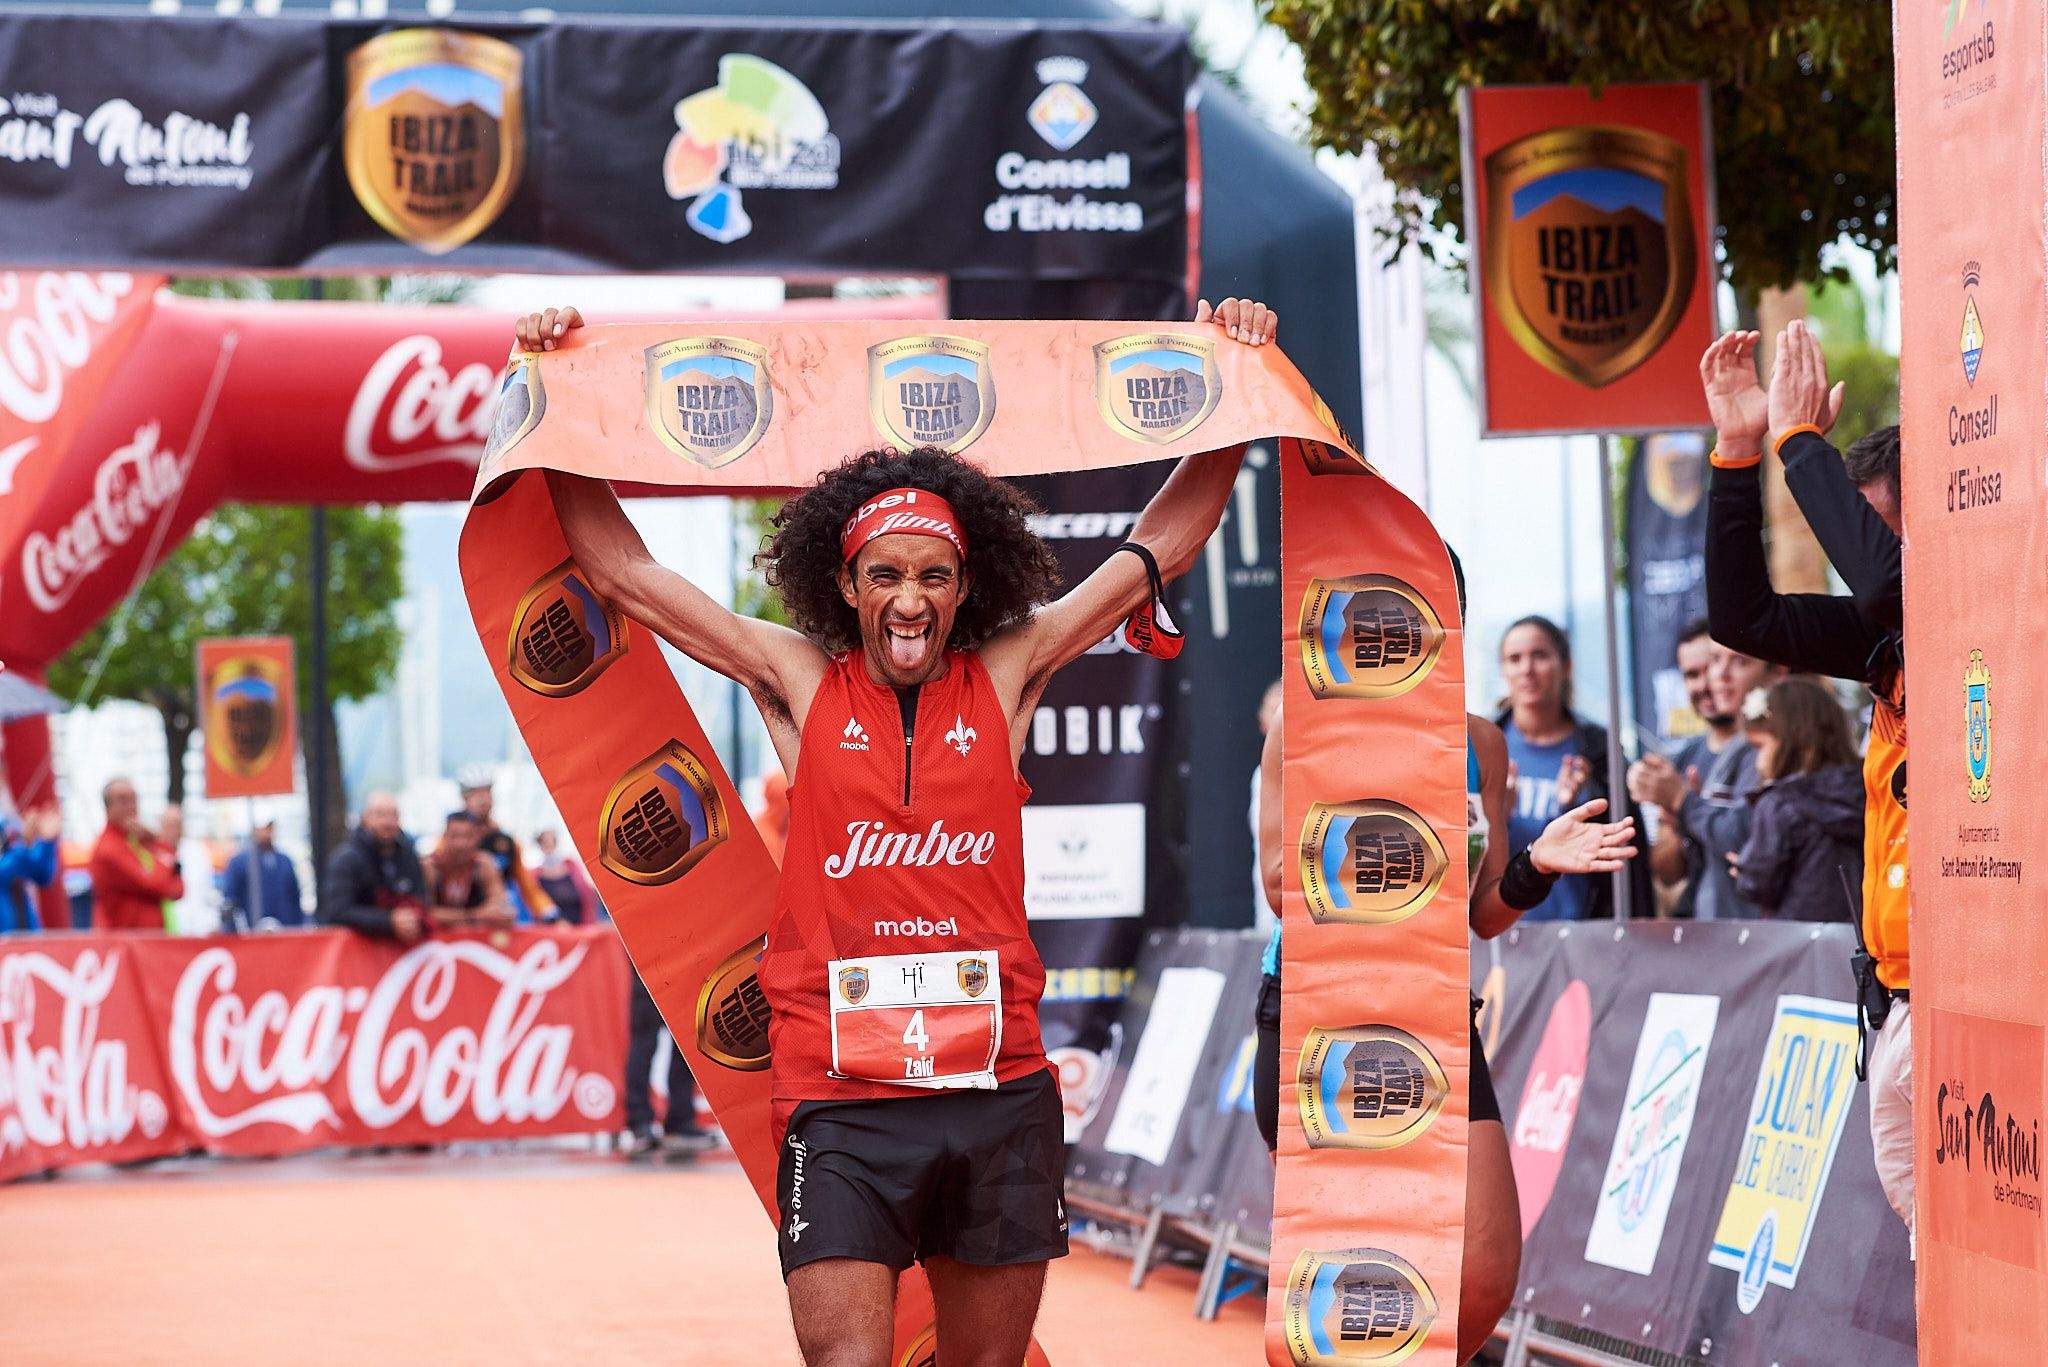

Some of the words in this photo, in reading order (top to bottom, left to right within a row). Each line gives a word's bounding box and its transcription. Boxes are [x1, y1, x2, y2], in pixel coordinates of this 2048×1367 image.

[83, 98, 255, 167] Antoni
[391, 115, 480, 156] IBIZA
[394, 157, 478, 197] TRAIL
[996, 153, 1131, 190] Consell
[984, 196, 1144, 232] d'Eivissa
[1538, 223, 1640, 273] IBIZA
[1543, 272, 1640, 323] TRAIL
[677, 385, 739, 410] IBIZA
[900, 382, 962, 407] IBIZA
[1126, 376, 1188, 399] IBIZA
[1128, 397, 1190, 419] TRAIL
[678, 408, 740, 436] TRAIL
[901, 405, 962, 431] TRAIL
[1948, 393, 1997, 447] Consell
[1947, 466, 2002, 513] d'Eivissa
[842, 491, 917, 542] obel
[529, 610, 568, 673] TRAIL
[545, 595, 588, 661] IBIZA
[1305, 628, 1314, 639] de
[1354, 607, 1383, 669] IBIZA
[1379, 607, 1411, 667] TRAIL
[1307, 640, 1319, 671] Antoni
[1314, 672, 1328, 692] Sant
[1022, 704, 1145, 755] OBIK
[621, 800, 664, 862] TRAIL
[640, 785, 683, 848] IBIZA
[1307, 809, 1328, 850] Portmany
[824, 820, 996, 879] Jimbee
[1305, 852, 1315, 863] de
[1355, 832, 1384, 894] IBIZA
[1382, 832, 1413, 893] TRAIL
[1942, 857, 1954, 877] Sant
[1954, 855, 1978, 877] Antoni
[1979, 855, 1987, 877] de
[1988, 857, 2022, 884] Portmany
[1307, 864, 1319, 895] Antoni
[874, 916, 959, 937] mobel
[1315, 897, 1328, 917] Sant
[170, 940, 590, 1137] Coca-Cola
[902, 1009, 930, 1052] 4
[904, 1055, 936, 1079] Zaid
[1304, 1077, 1313, 1088] de
[1304, 1089, 1317, 1121] Antoni
[1353, 1058, 1383, 1119] IBIZA
[1380, 1058, 1412, 1118] TRAIL
[1949, 1078, 1966, 1102] Visit
[1312, 1122, 1324, 1141] Sant
[1936, 1082, 1974, 1173] Sant
[1976, 1092, 2041, 1183] Antoni
[788, 1133, 808, 1211] Jimbee
[1993, 1181, 2005, 1202] de
[2005, 1183, 2042, 1218] Portmany
[1341, 1280, 1372, 1341] IBIZA
[1367, 1280, 1400, 1341] TRAIL
